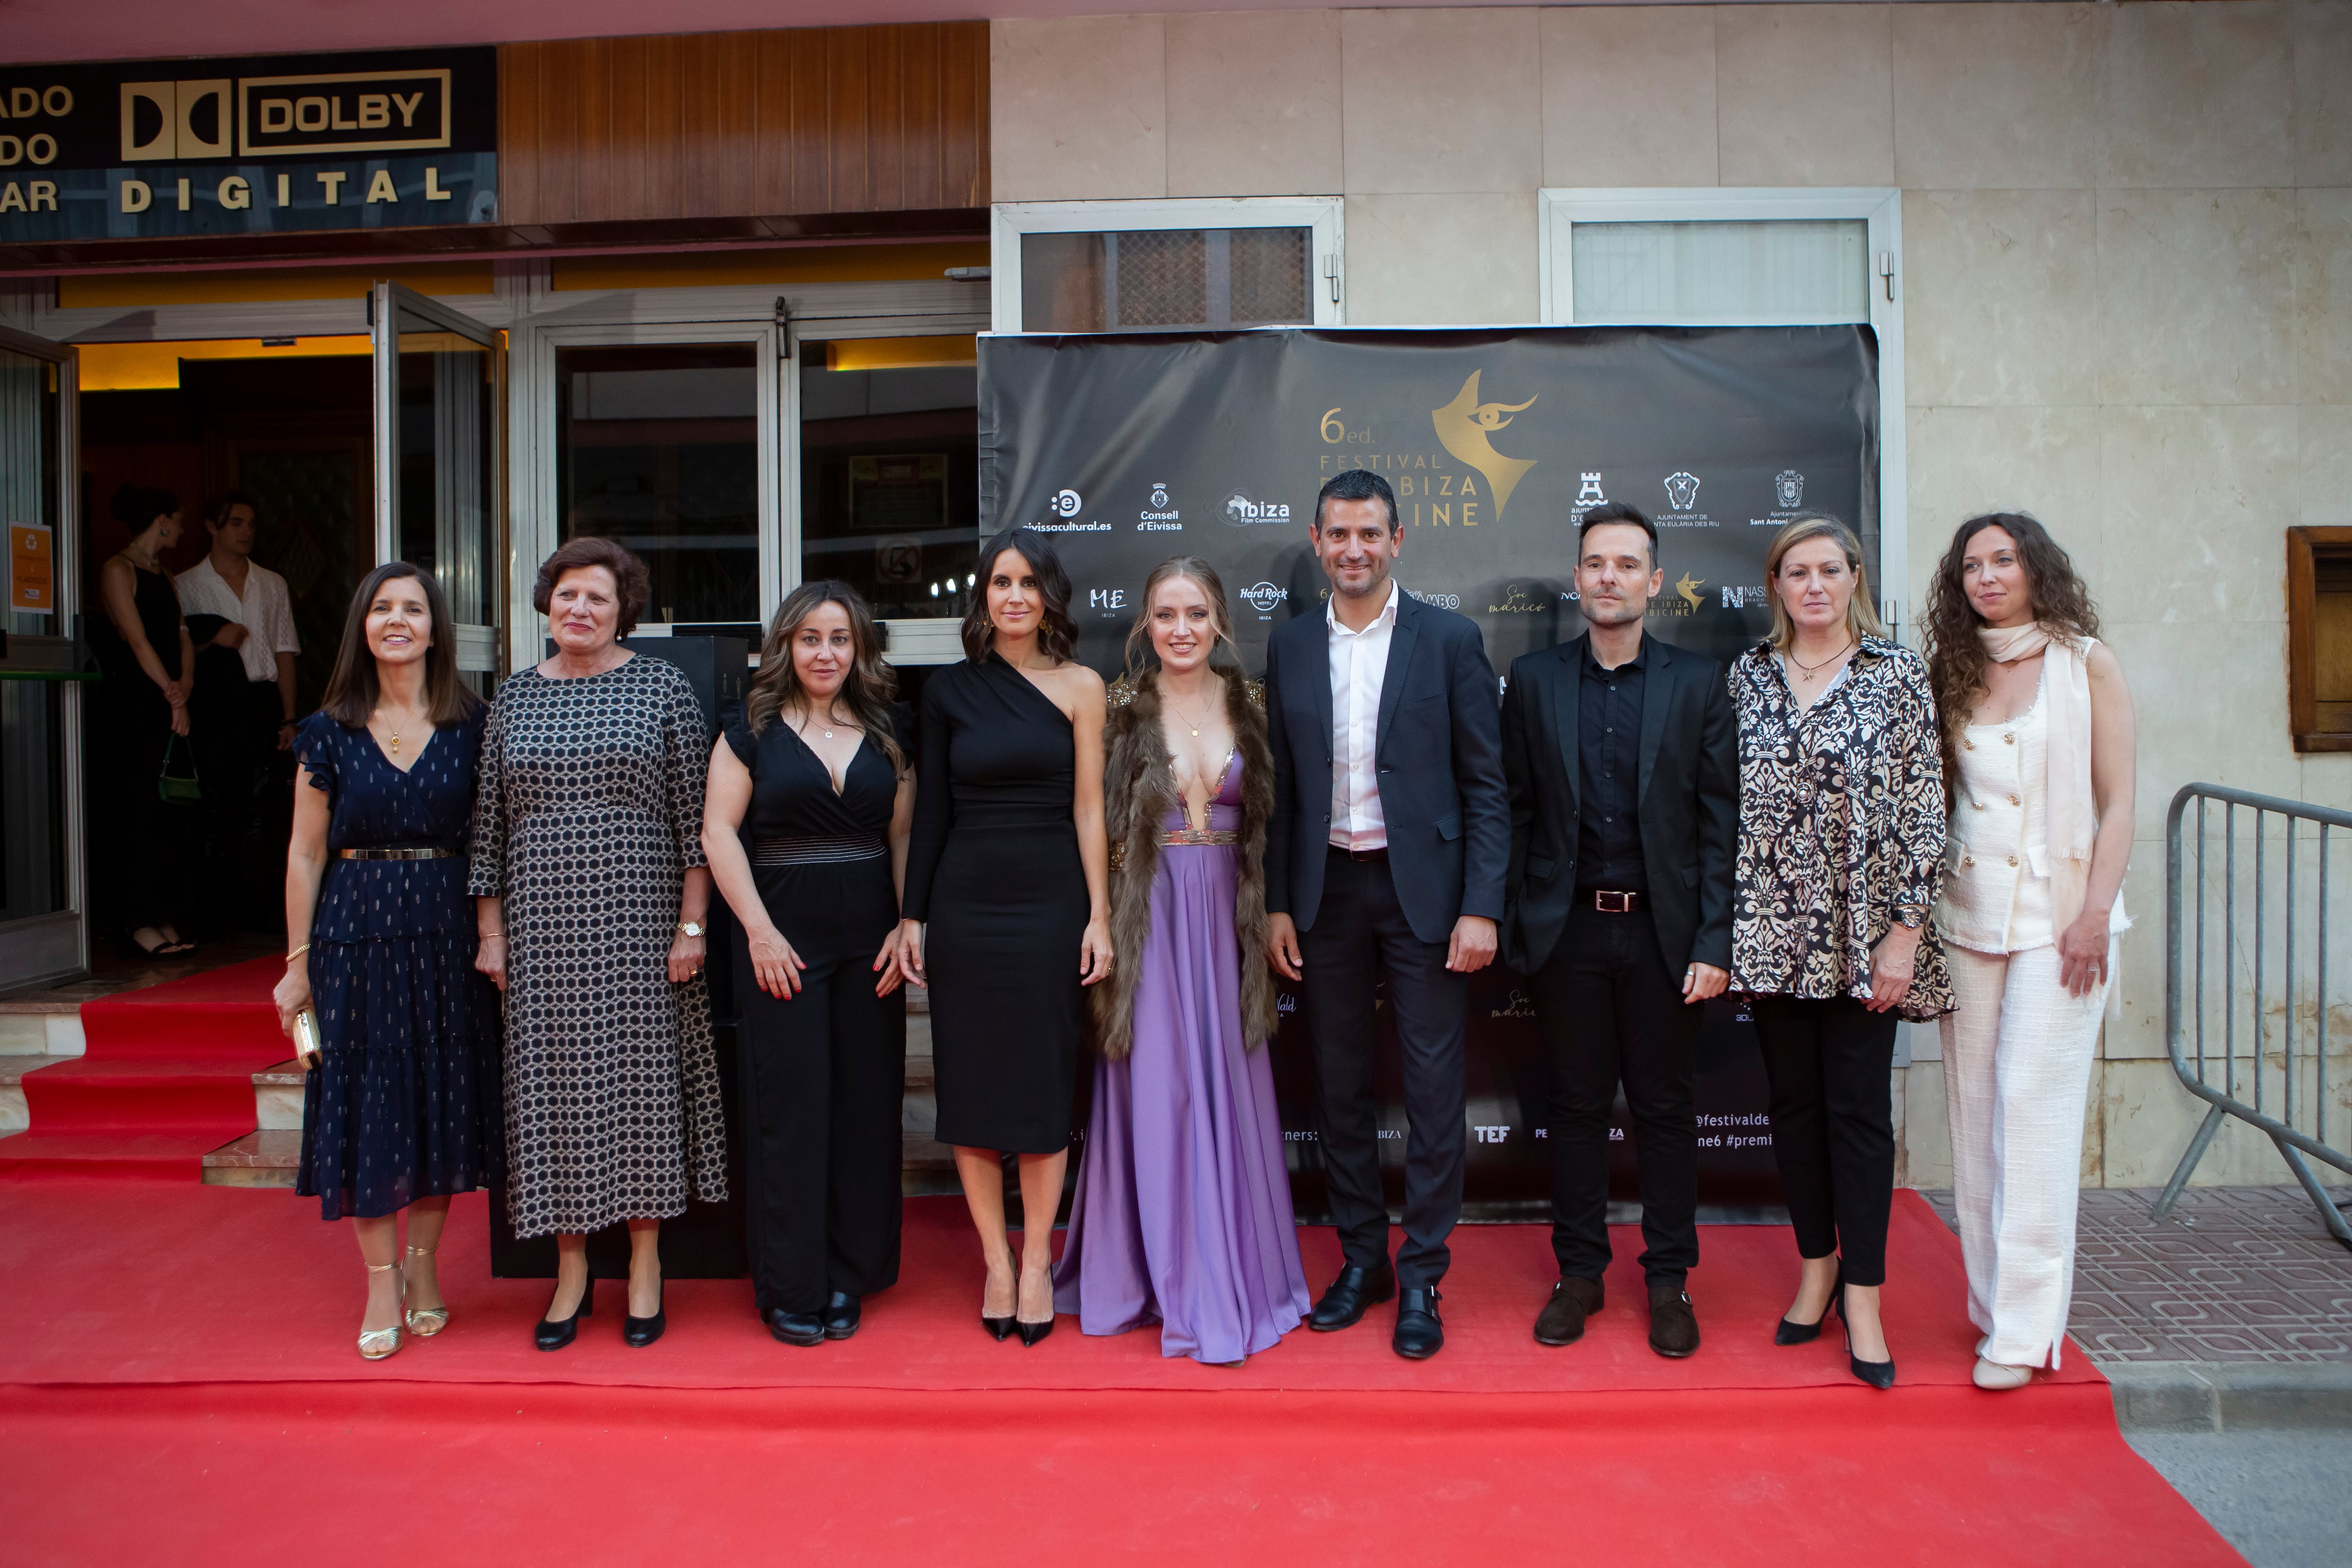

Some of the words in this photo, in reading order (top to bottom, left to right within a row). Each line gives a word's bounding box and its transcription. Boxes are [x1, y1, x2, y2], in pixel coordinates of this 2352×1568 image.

[261, 92, 424, 133] DOLBY
[121, 167, 452, 214] DIGITAL
[1320, 454, 1441, 470] FESTIVAL
[1385, 476, 1477, 496] BIZA
[1140, 510, 1179, 520] Consell
[1090, 588, 1127, 609] ME
[1240, 587, 1263, 600] Hard
[1264, 588, 1288, 600] Rock
[1473, 1126, 1510, 1143] TEF
